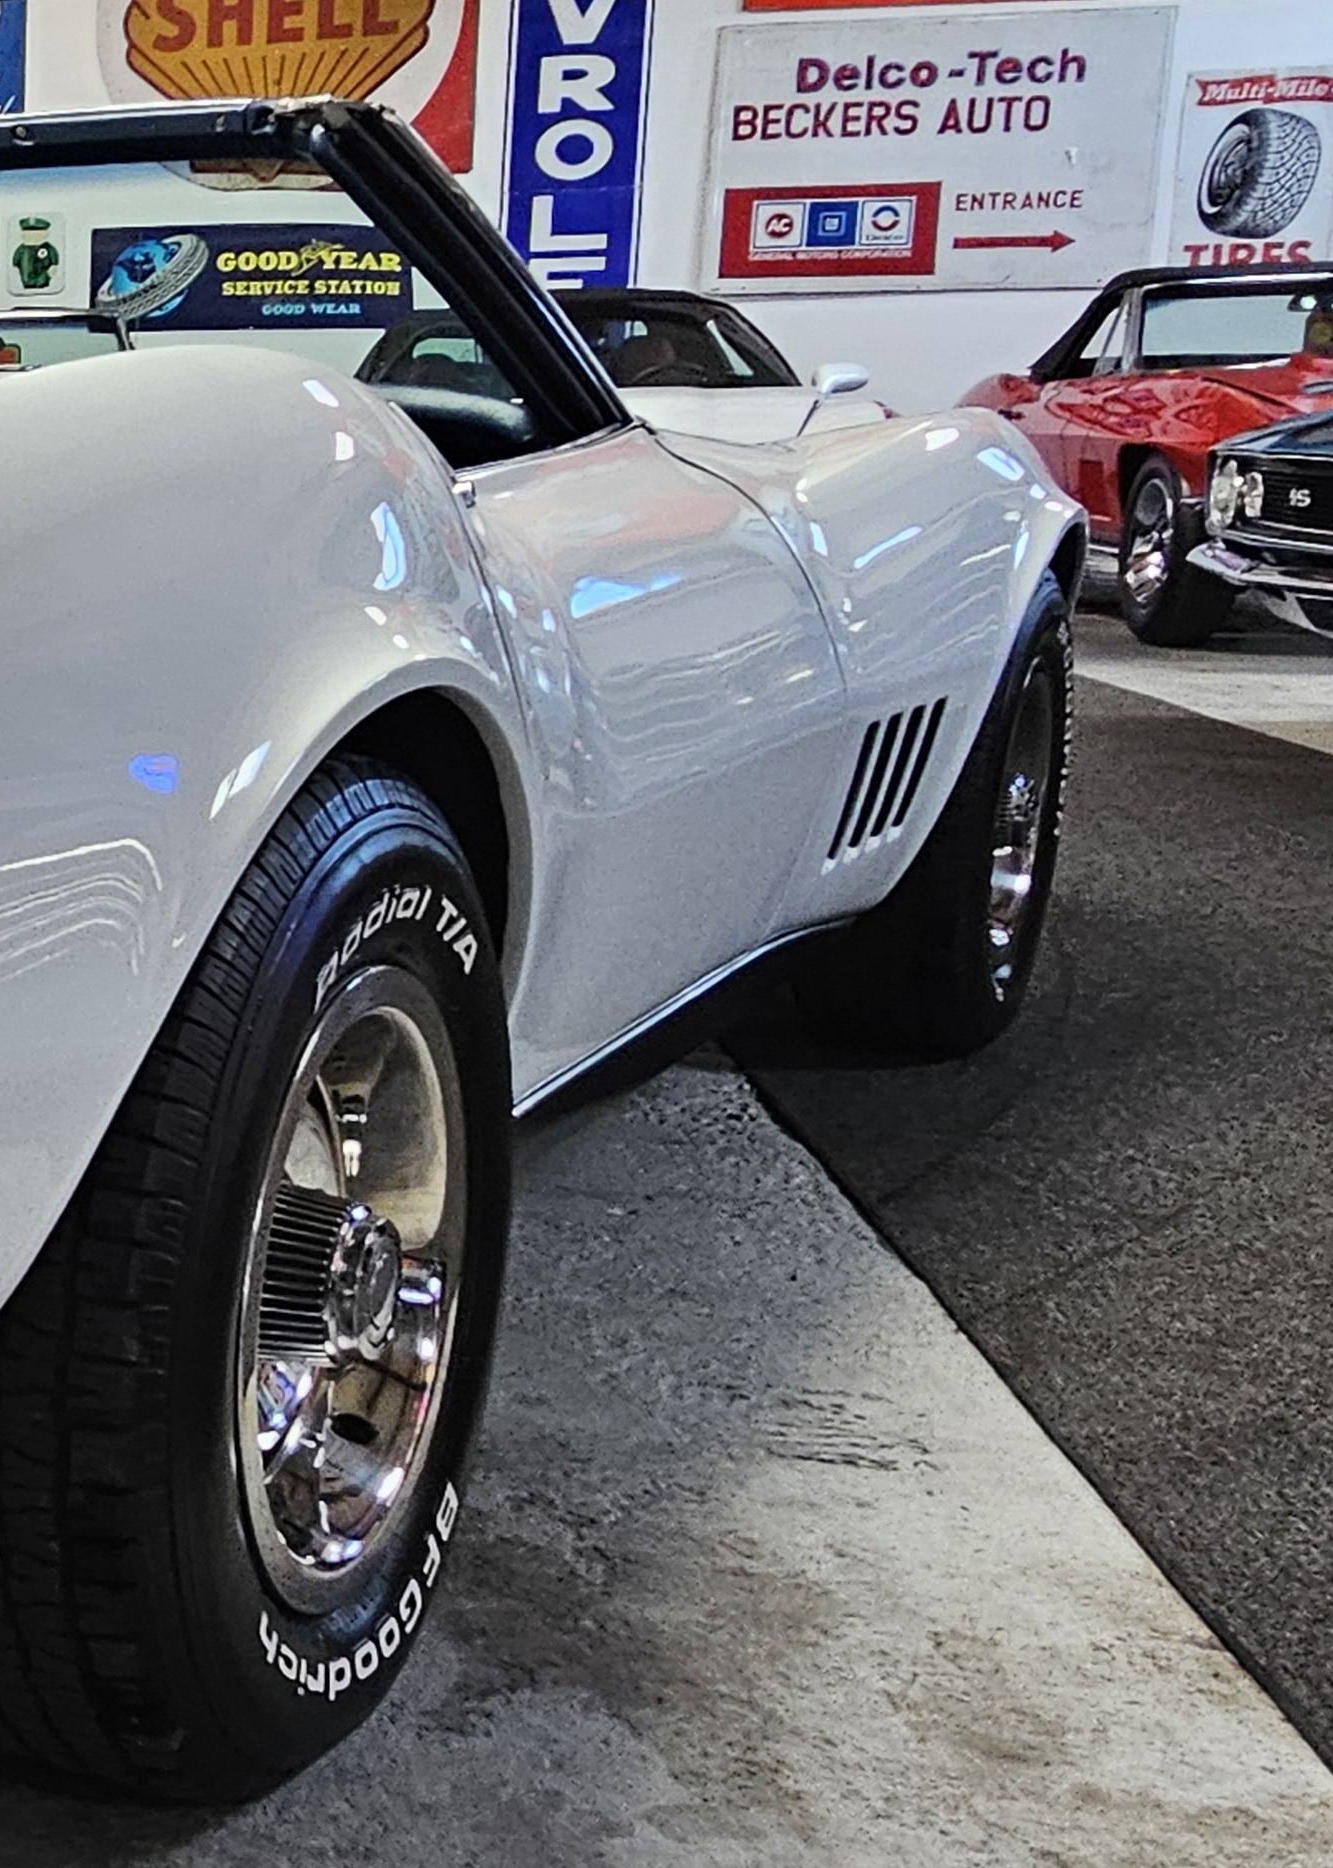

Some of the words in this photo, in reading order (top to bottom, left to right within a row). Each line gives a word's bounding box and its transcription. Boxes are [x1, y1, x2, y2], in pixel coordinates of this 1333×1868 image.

[152, 0, 399, 52] SHELL
[732, 100, 920, 141] BECKERS
[937, 95, 1051, 135] AUTO
[954, 189, 1084, 212] ENTRANCE
[767, 217, 791, 233] AC
[748, 250, 793, 261] GENERAL
[795, 250, 839, 260] MOTORS
[840, 248, 912, 260] CORPORATION
[1183, 240, 1312, 267] TIRES
[222, 280, 310, 296] SERVICE
[313, 280, 400, 296] STATION
[262, 303, 305, 316] GOOD
[312, 303, 361, 315] WEAR
[313, 884, 432, 1015] Radial
[436, 895, 478, 975] T/A
[259, 1482, 459, 1701] BFGoodrich
